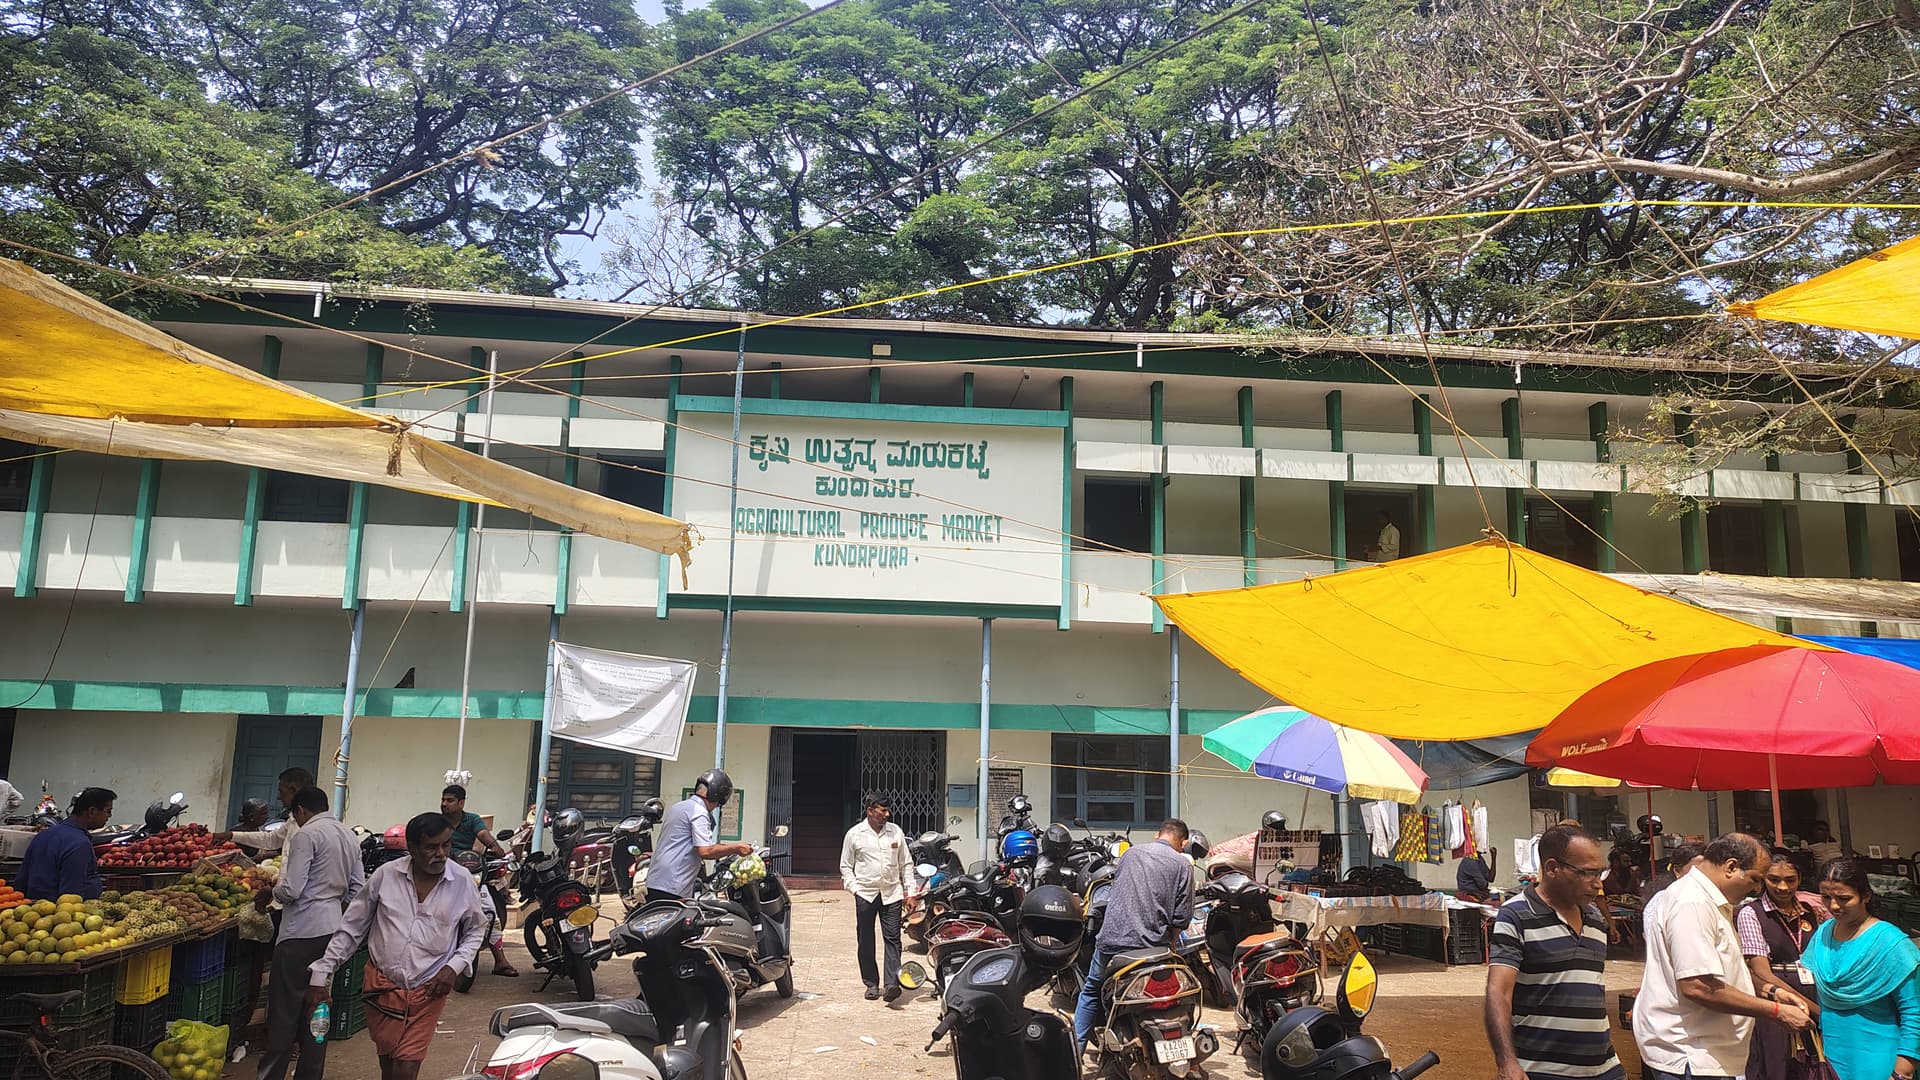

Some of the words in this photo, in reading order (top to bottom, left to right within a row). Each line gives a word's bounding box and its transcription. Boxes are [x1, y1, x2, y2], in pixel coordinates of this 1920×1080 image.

[749, 435, 790, 471] ಕೃಷಿ
[805, 438, 877, 473] ಉತ್ಪನ್ನ
[735, 507, 846, 539] AGRICULTURAL
[859, 511, 929, 541] PRODUCE
[941, 513, 1003, 543] MARKET
